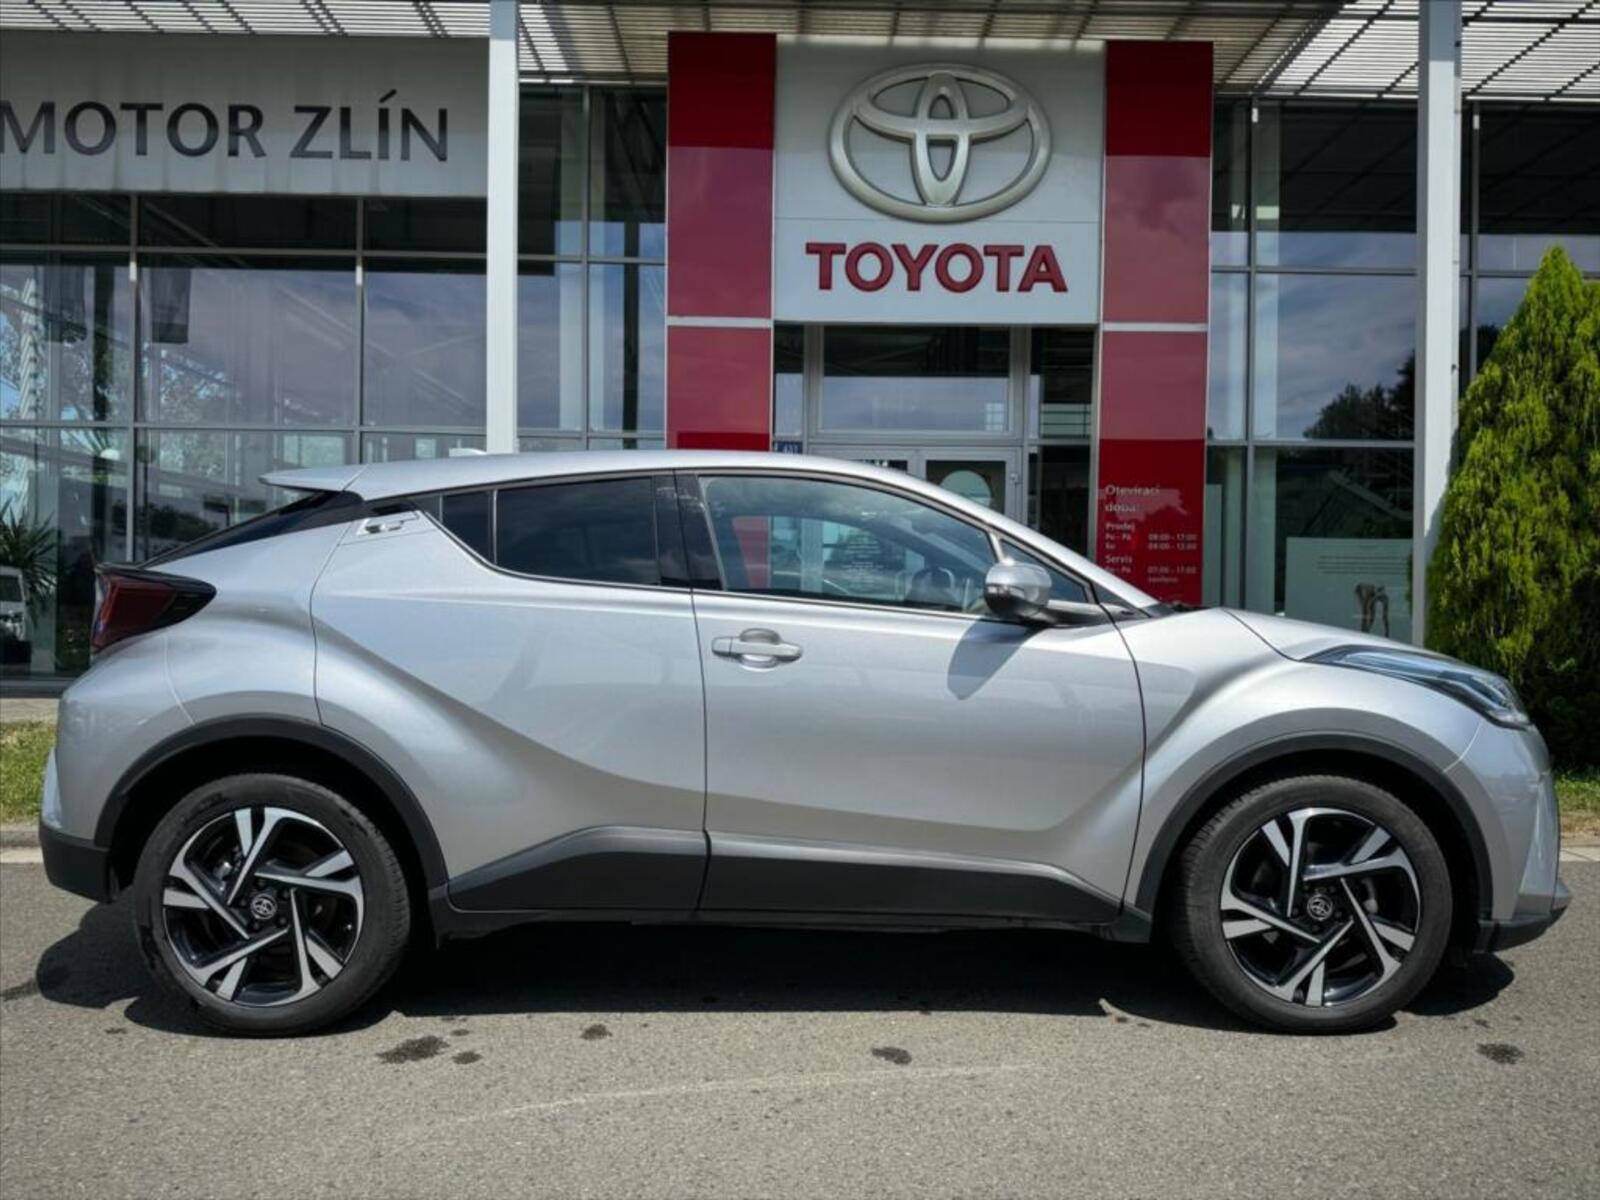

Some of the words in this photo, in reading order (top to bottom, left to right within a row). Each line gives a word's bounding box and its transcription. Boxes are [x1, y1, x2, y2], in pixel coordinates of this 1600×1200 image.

[0, 101, 267, 157] MOTOR
[290, 89, 448, 162] ZLÍN
[805, 242, 1069, 293] TOYOTA
